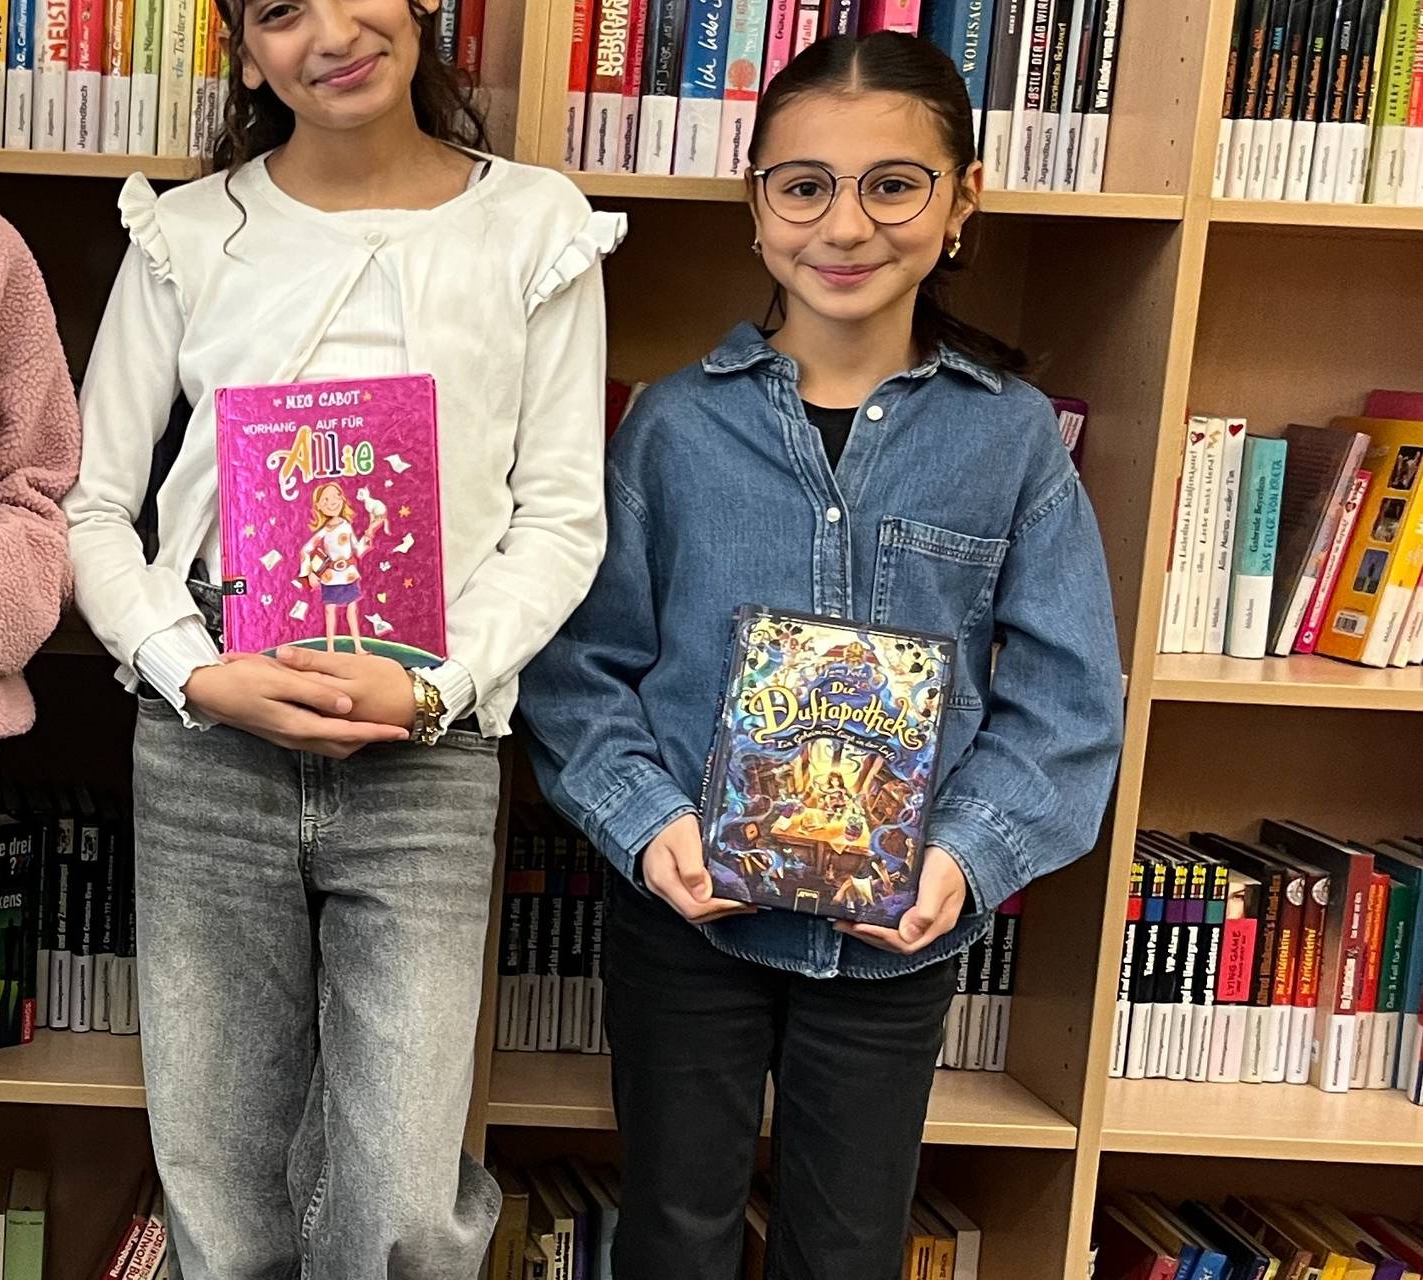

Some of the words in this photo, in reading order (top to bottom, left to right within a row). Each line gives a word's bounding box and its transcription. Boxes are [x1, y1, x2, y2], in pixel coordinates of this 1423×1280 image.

[78, 85, 88, 148] Jugendbuch
[597, 108, 608, 165] Jugendbuch
[622, 114, 634, 170] Jugendbuch
[730, 118, 742, 175] Jugendbuch
[1021, 126, 1033, 182] Jugendbuch
[1038, 128, 1053, 185] Jugendbuch
[242, 421, 296, 435] VORHANG
[316, 419, 339, 431] AUF
[341, 415, 364, 429] FÜR
[285, 392, 314, 410] MEG
[318, 390, 360, 407] CABOT
[266, 425, 374, 502] Allie
[235, 581, 245, 595] cb
[831, 681, 860, 696] Die
[749, 686, 924, 750] Duftapotheke
[9, 835, 32, 856] drei
